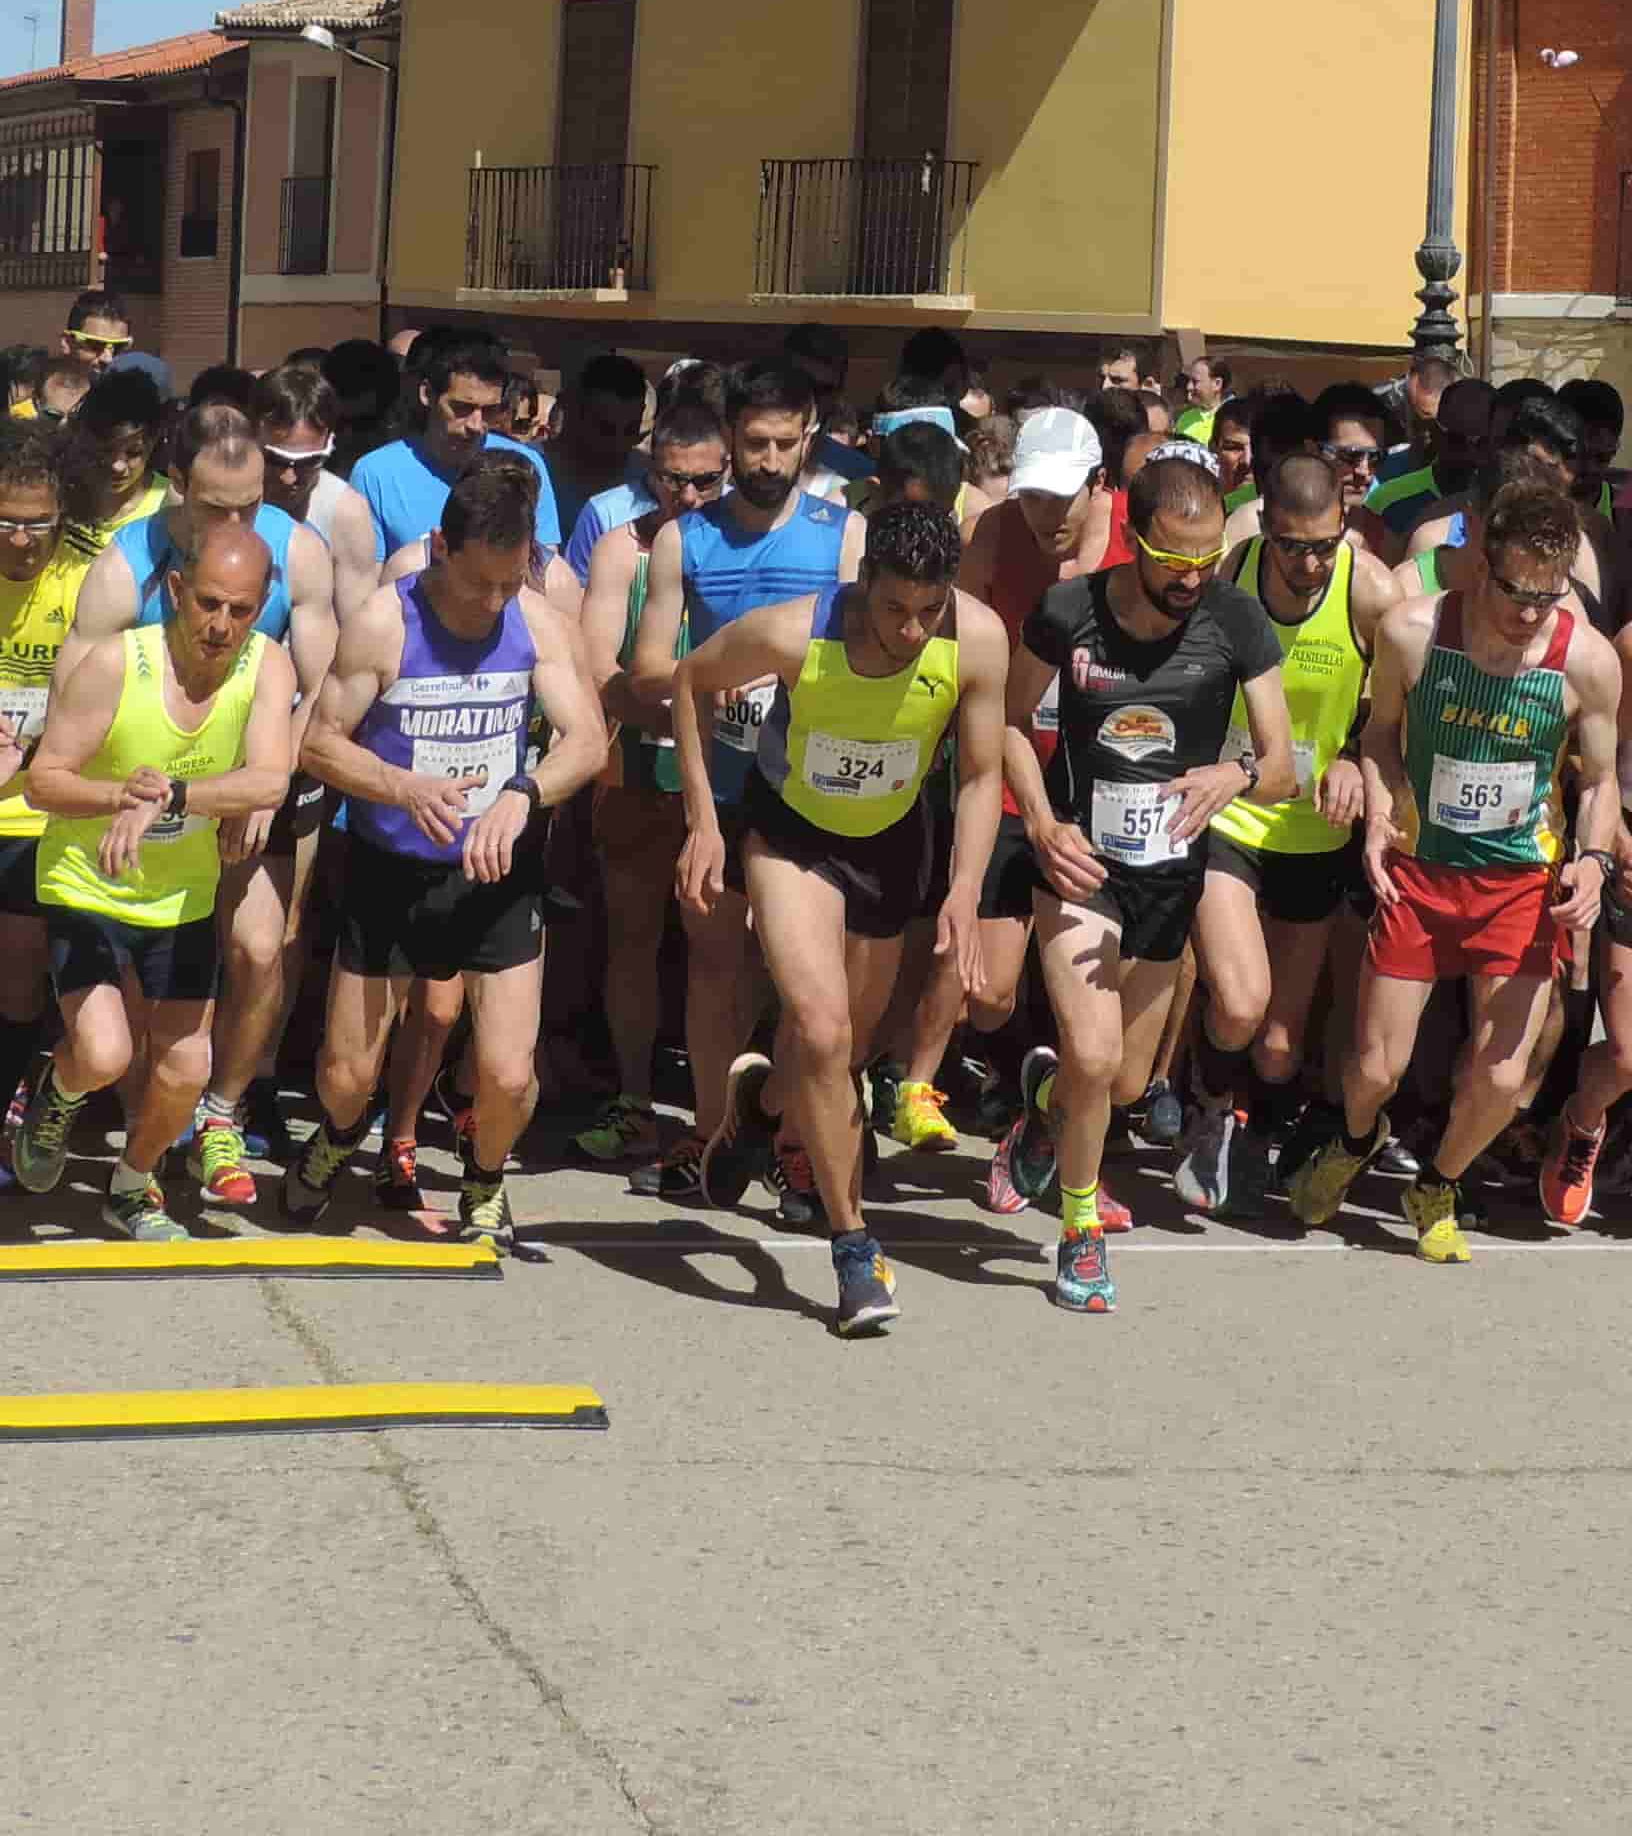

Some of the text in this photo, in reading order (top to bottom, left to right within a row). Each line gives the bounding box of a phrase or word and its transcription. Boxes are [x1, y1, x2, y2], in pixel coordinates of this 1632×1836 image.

[837, 756, 885, 780] 324
[1459, 783, 1503, 807] 563
[1123, 806, 1165, 836] 557
